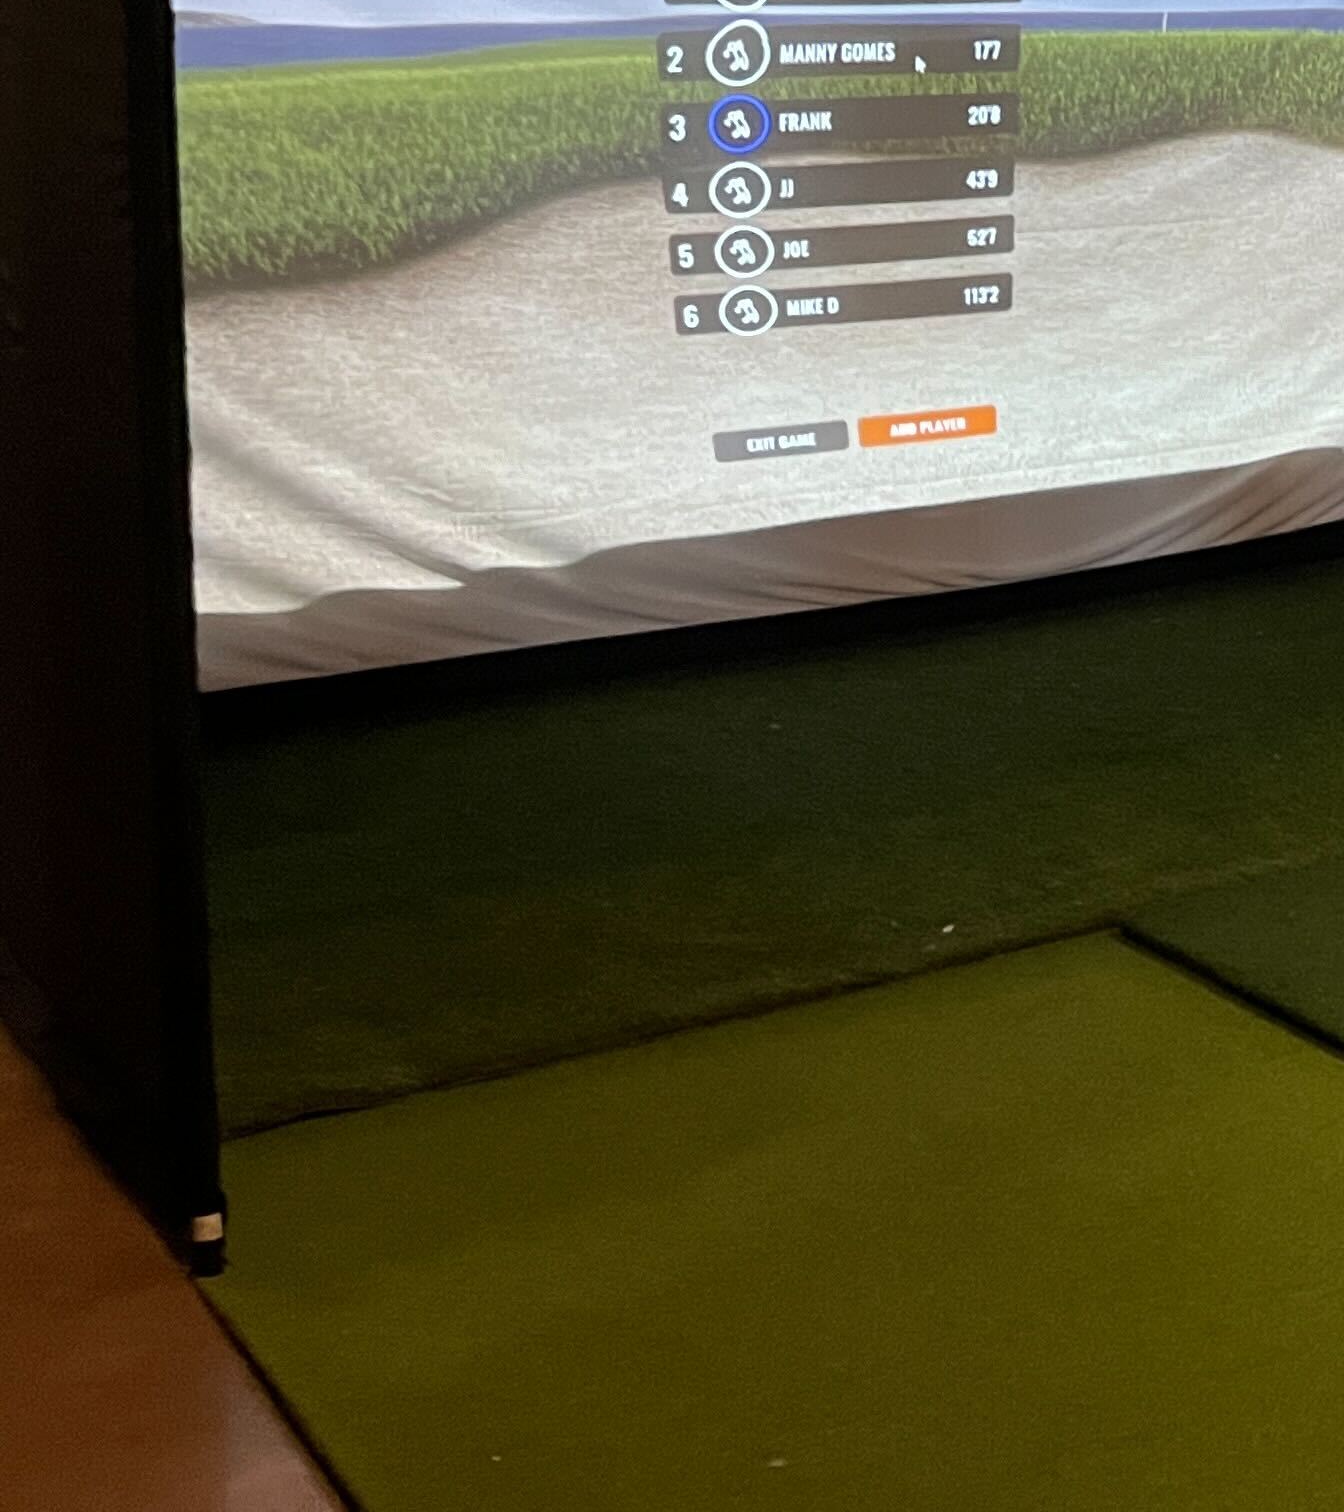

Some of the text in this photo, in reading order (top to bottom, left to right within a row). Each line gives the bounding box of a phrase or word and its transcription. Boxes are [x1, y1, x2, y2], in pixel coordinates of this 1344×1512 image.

[666, 45, 684, 73] 2
[779, 42, 837, 64] MANNY
[841, 42, 896, 62] GOMES
[668, 114, 686, 142] 3
[778, 110, 832, 132] FRANK
[671, 182, 689, 208] 4
[779, 178, 795, 199] JJ
[677, 243, 695, 269] 5
[783, 240, 810, 259] JOE
[682, 304, 700, 329] 6
[786, 298, 824, 316] MIKE
[826, 297, 839, 314] D
[919, 417, 966, 434] PLAYER
